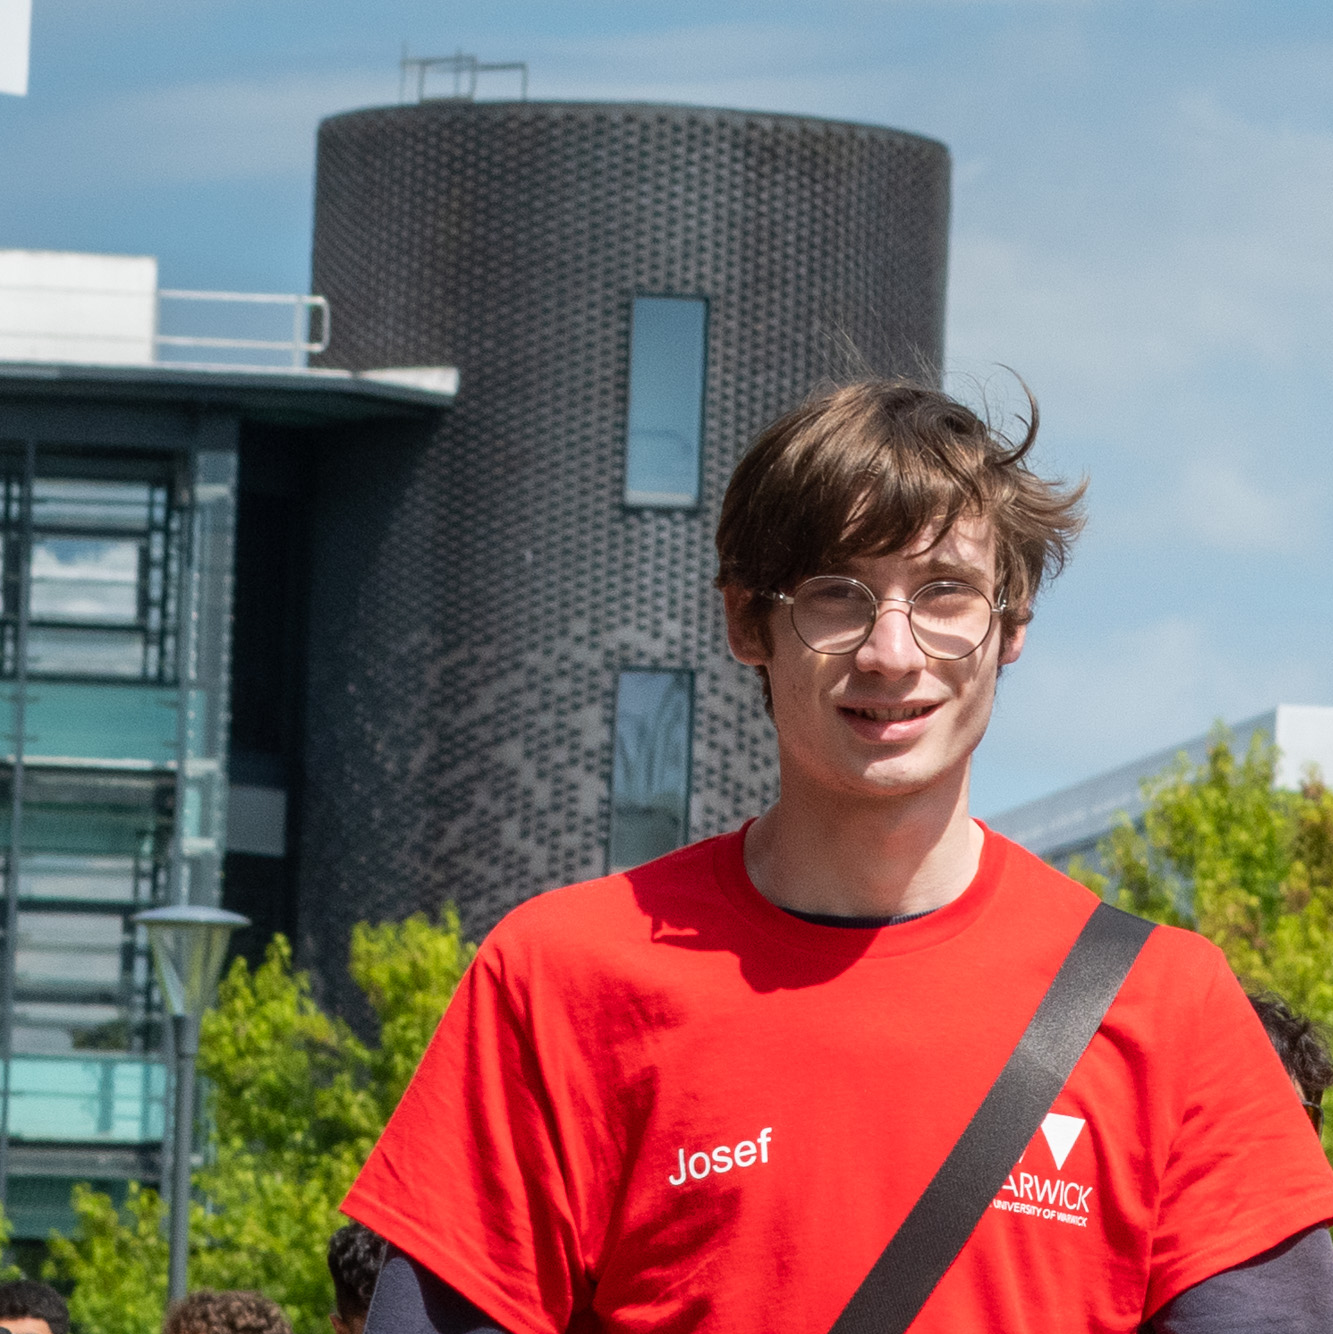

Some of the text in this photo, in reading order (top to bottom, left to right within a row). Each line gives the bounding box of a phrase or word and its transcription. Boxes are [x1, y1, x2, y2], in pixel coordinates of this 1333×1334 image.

[668, 1127, 773, 1186] Josef
[992, 1198, 1043, 1217] UNIVERSITY
[1042, 1208, 1057, 1220] OF
